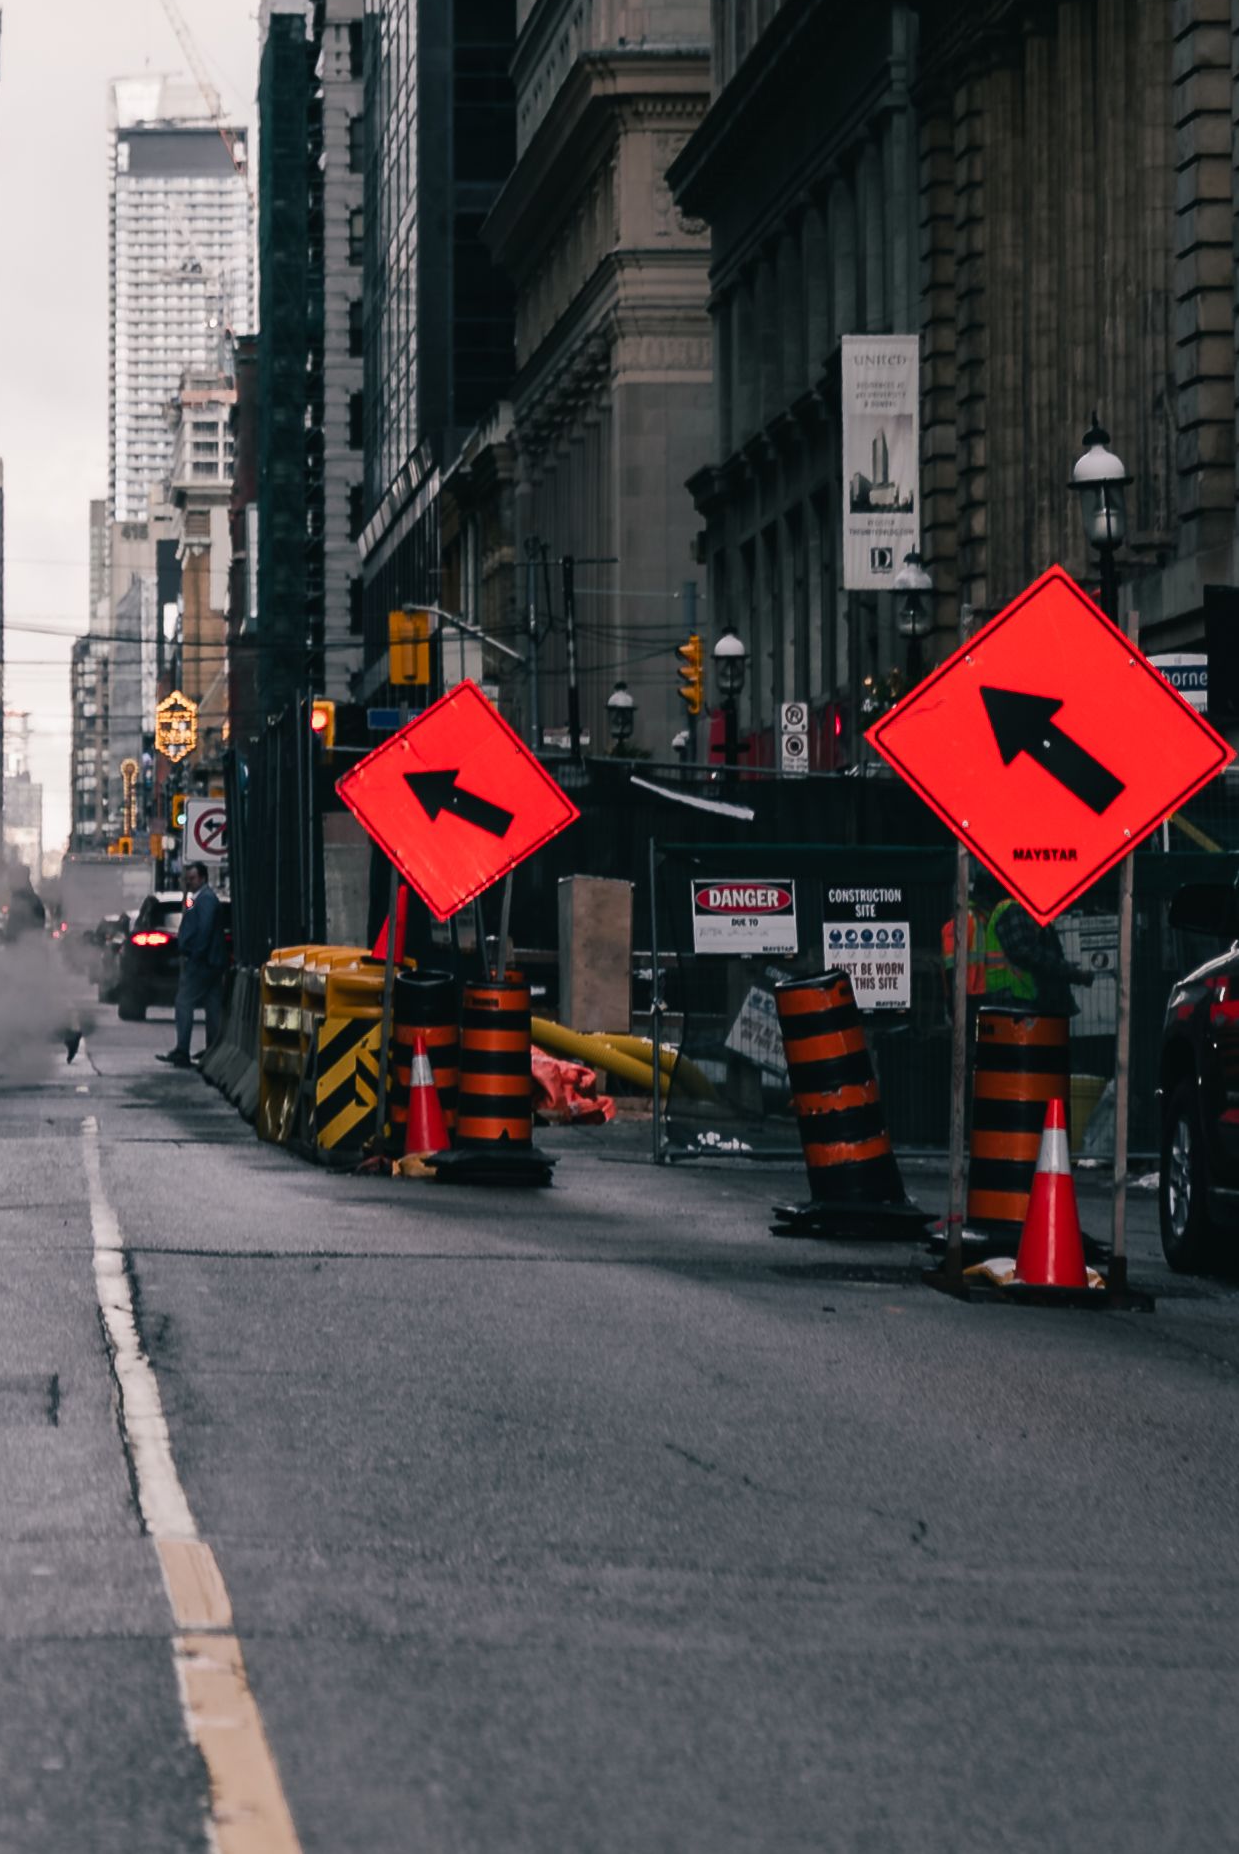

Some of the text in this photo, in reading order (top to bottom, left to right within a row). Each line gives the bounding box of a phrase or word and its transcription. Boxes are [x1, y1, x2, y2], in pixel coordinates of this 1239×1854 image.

[1012, 847, 1078, 862] MAYSTAR
[709, 889, 779, 908] DANGER
[828, 889, 902, 903] CONSTRUCTION
[855, 904, 876, 917] SITE
[731, 918, 759, 927] DUE TO
[861, 962, 872, 975] BE
[875, 962, 905, 975] WORN
[854, 977, 899, 990] THIS SITE
